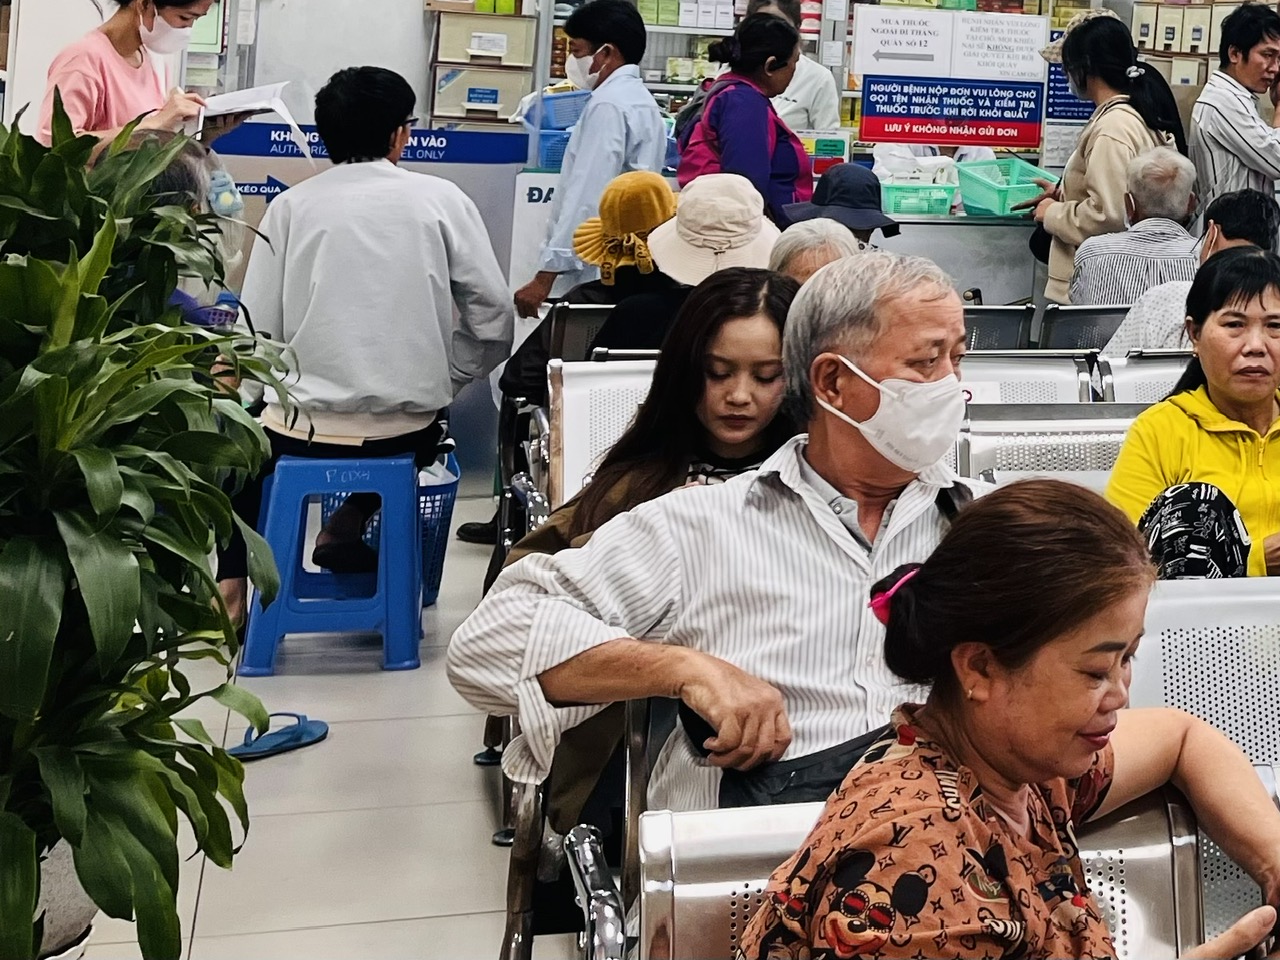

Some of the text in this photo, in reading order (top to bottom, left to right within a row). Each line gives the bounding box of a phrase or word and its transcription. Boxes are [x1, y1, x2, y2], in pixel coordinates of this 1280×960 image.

[871, 83, 1036, 98] NGƯỜI BỆNH NỘP ĐƠN VUI LÒNG CHỜ
[870, 94, 888, 103] GỌI
[892, 93, 908, 103] TÊN
[943, 95, 974, 106] THUỐC
[978, 97, 990, 107] VÀ
[1020, 101, 1035, 109] TRA
[876, 103, 907, 113] THUỐC
[943, 107, 958, 116] KHI
[961, 107, 976, 116] RỜI
[884, 123, 902, 132] LƯU
[904, 123, 910, 133] Ý
[912, 123, 947, 134] KHÔNG
[949, 125, 976, 137] NHẬN
[420, 135, 447, 148] VÀO
[270, 144, 329, 155] AUTHRIZ
[416, 149, 446, 160] ONLY
[237, 184, 258, 193] KÉO
